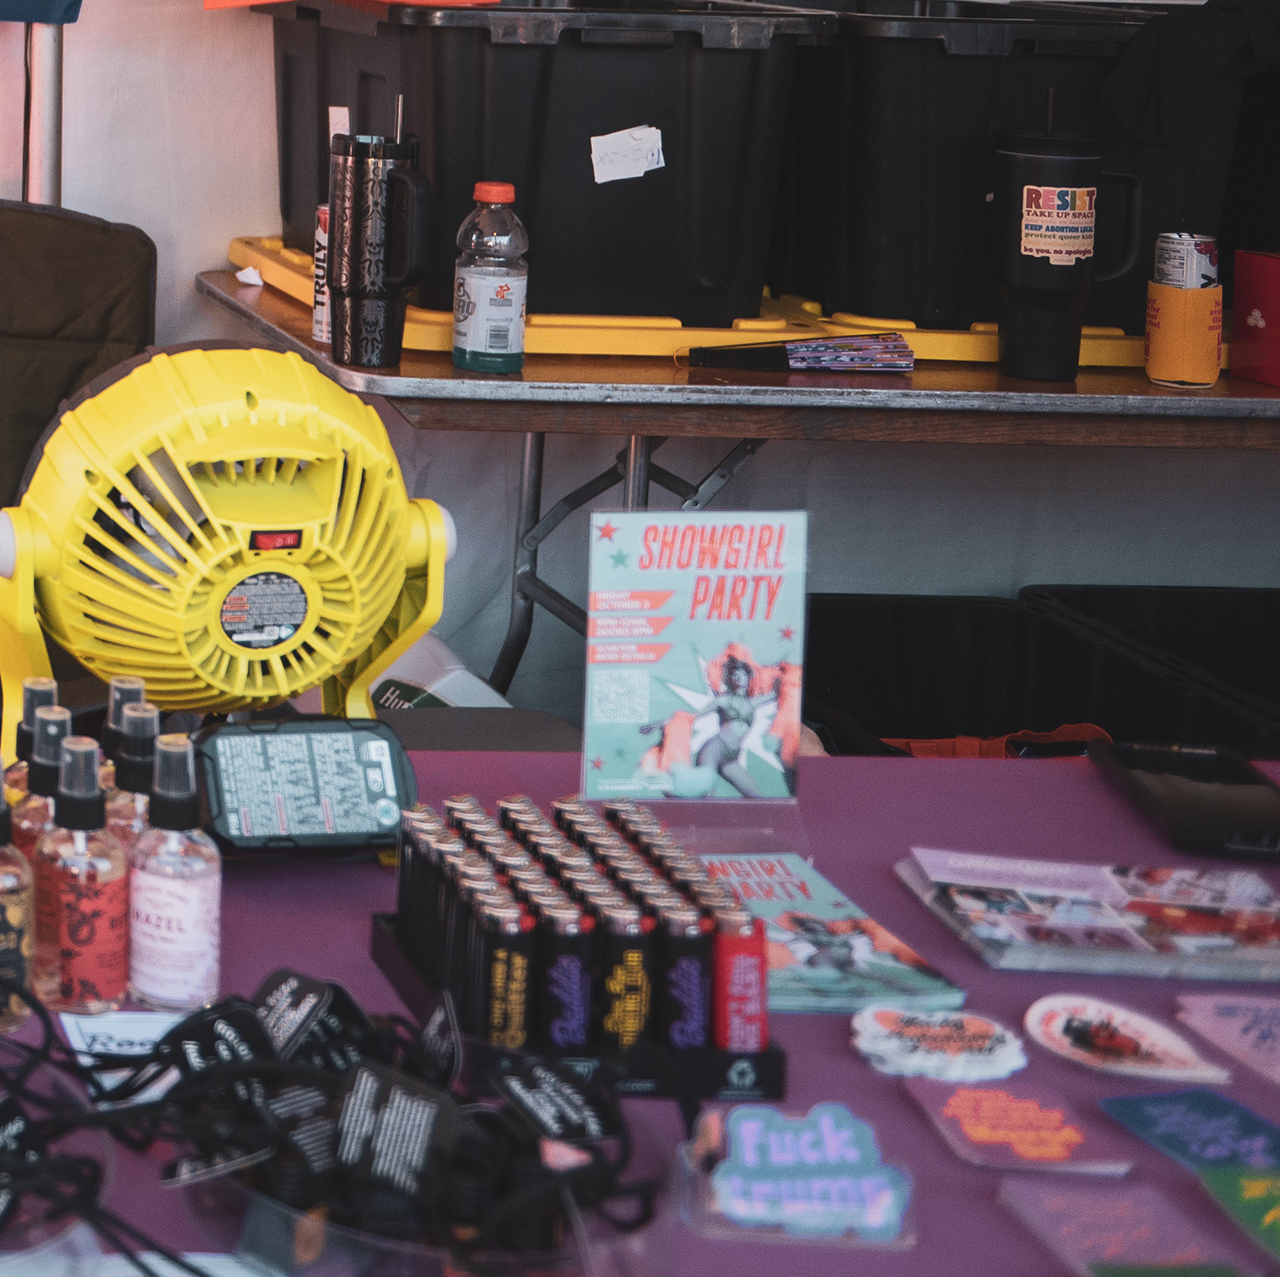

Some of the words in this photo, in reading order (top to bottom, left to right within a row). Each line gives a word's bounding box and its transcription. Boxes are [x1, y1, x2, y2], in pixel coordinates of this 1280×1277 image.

[1025, 188, 1095, 211] RESIST
[1025, 210, 1054, 218] TAKE
[1056, 211, 1070, 219] UP
[1045, 225, 1079, 233] ABORTION
[314, 240, 327, 310] TRULY
[639, 524, 786, 570] SHOWGIRL
[690, 575, 783, 621] PARTY
[739, 1115, 861, 1168] Fuck
